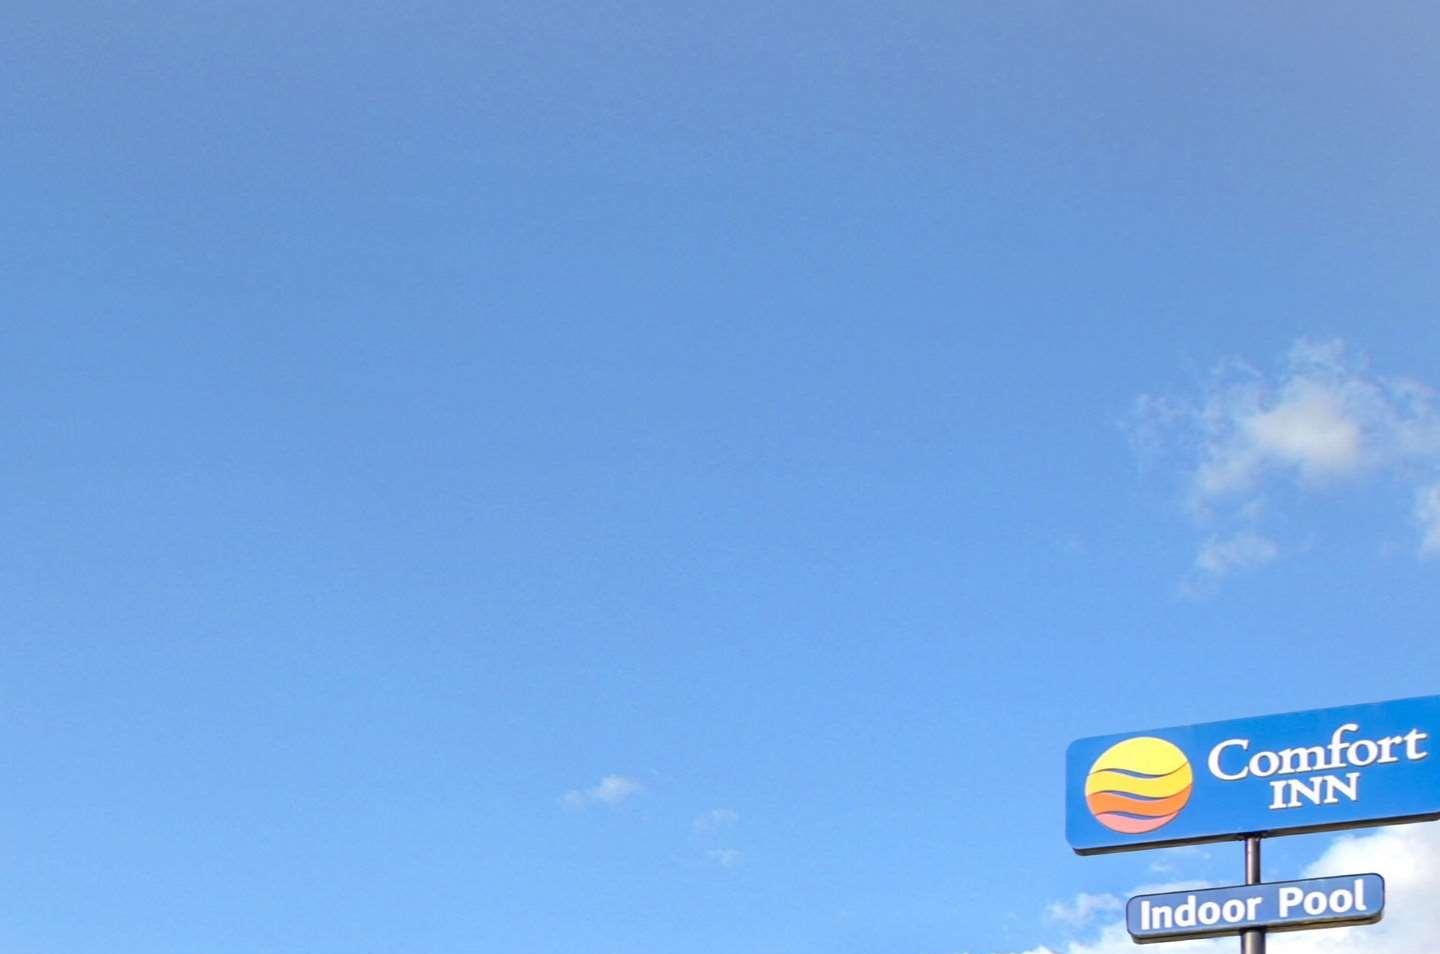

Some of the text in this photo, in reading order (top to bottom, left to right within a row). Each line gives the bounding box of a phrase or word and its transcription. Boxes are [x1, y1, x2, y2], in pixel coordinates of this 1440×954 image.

[1208, 723, 1428, 781] Comfort
[1268, 772, 1360, 809] INN
[1140, 879, 1367, 931] Indoor Pool
